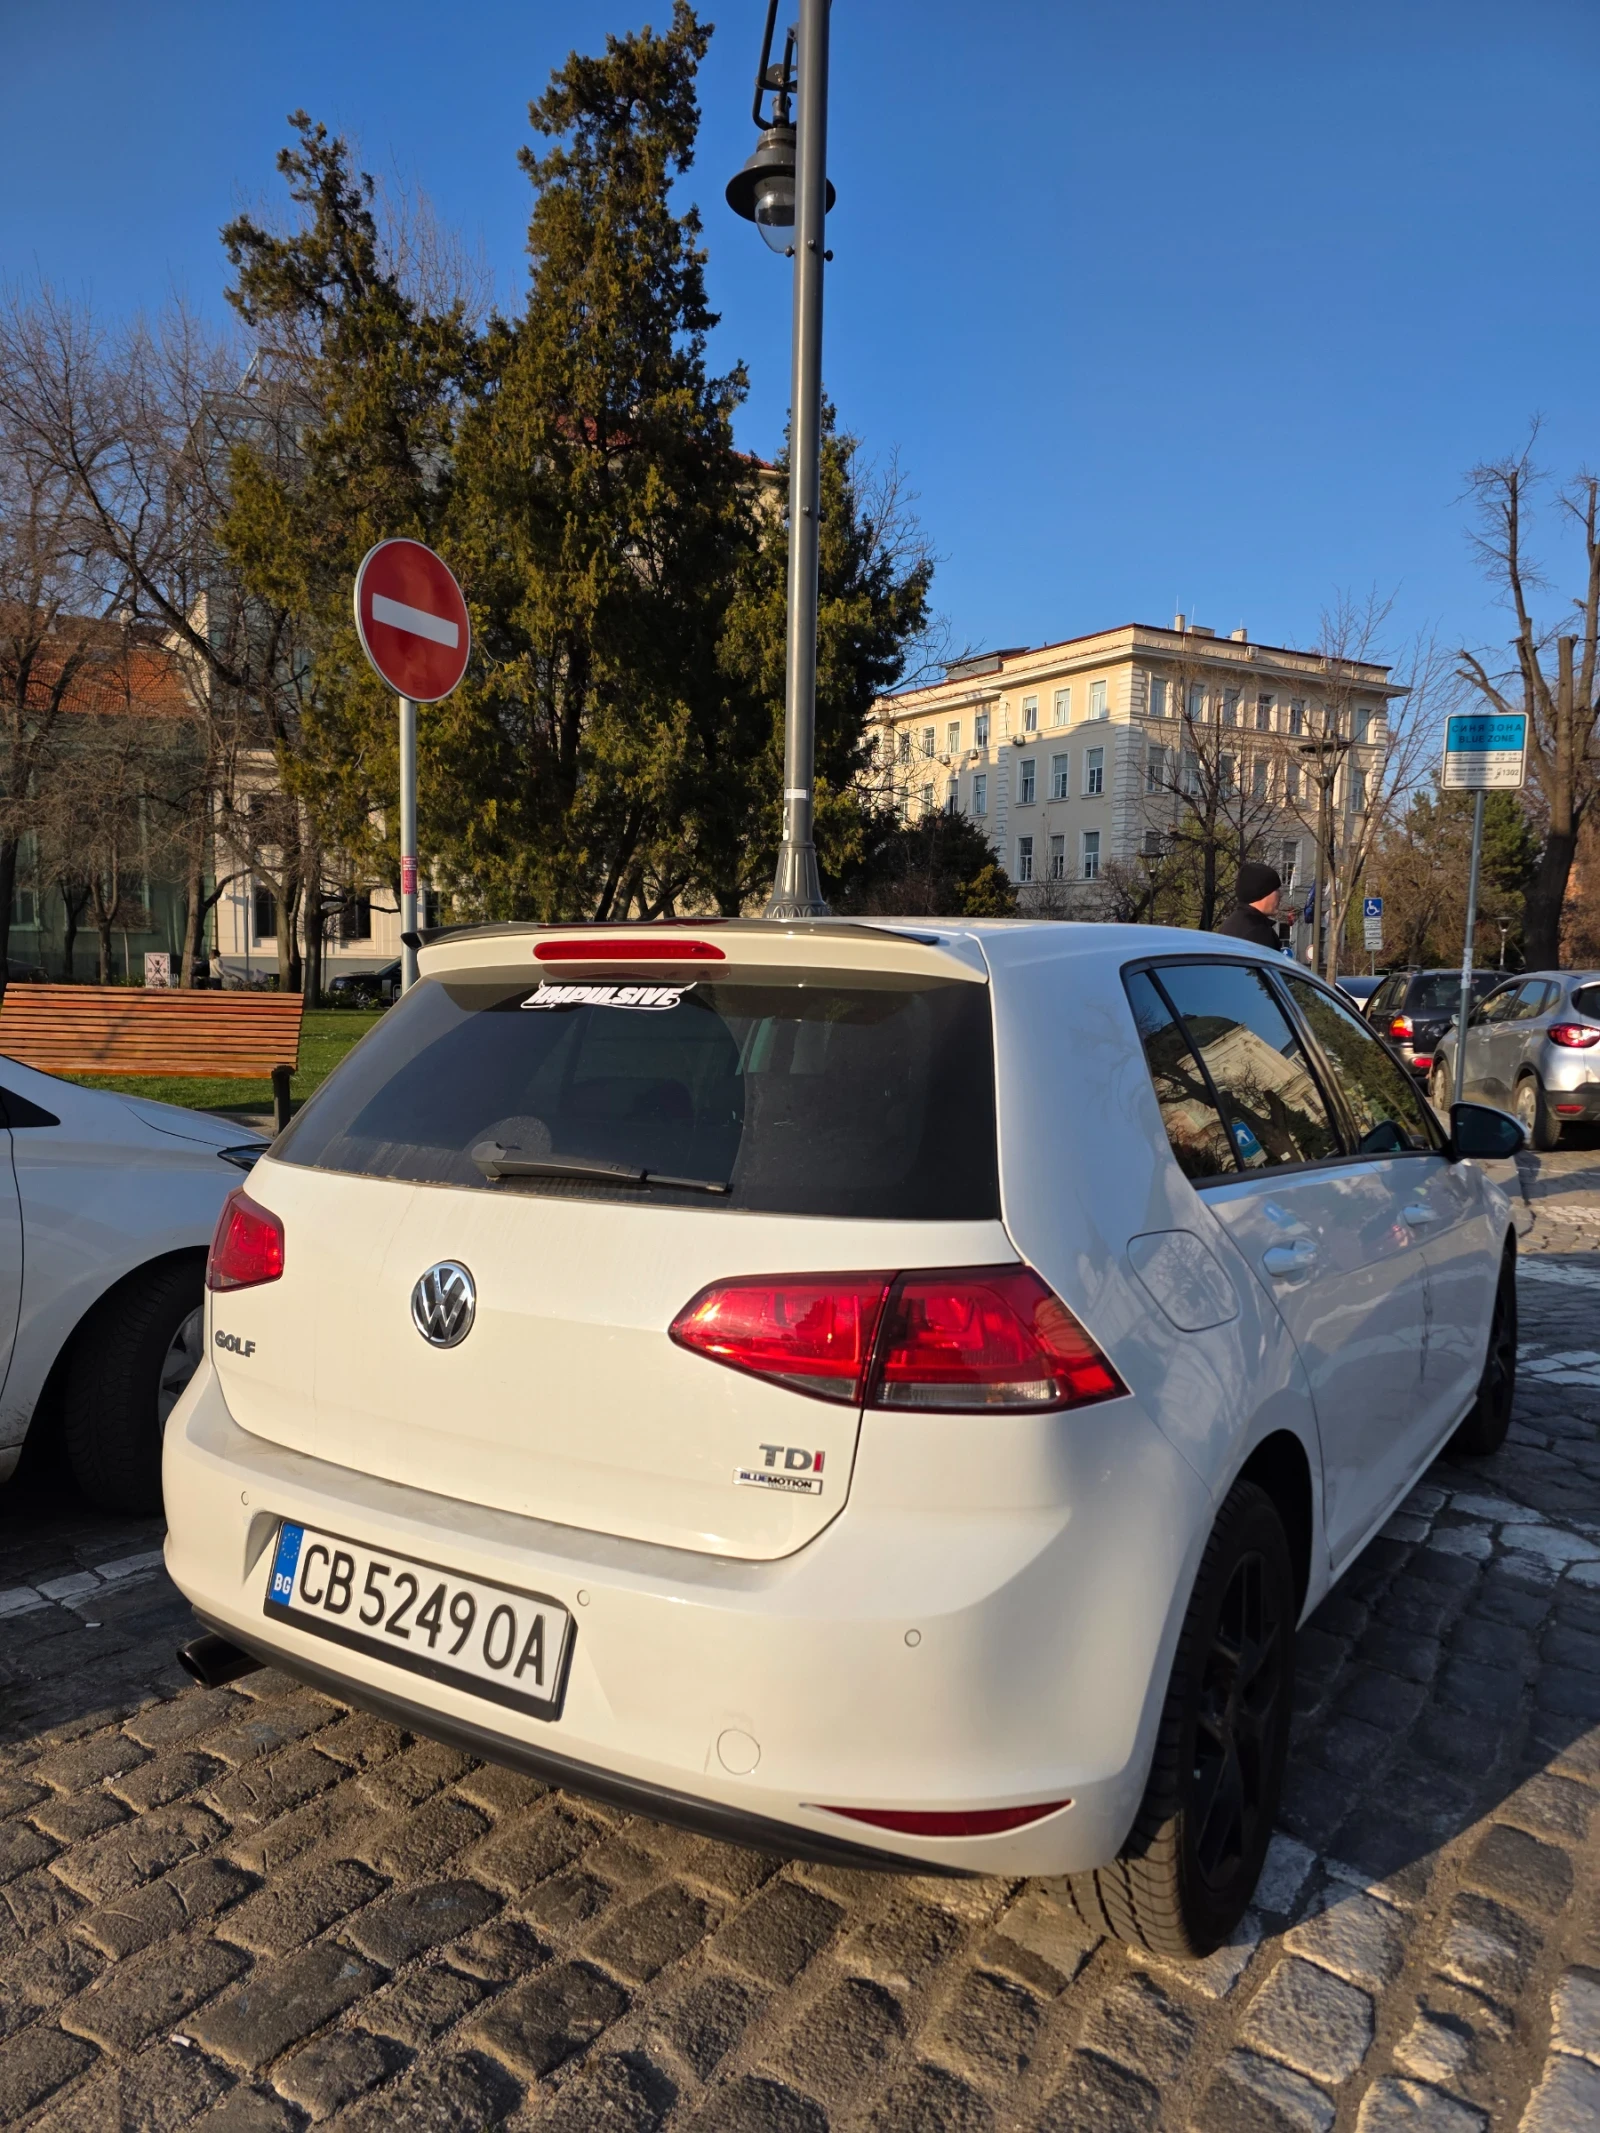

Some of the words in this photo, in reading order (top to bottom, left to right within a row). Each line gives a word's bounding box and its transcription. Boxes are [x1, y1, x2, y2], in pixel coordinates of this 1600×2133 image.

[1451, 724, 1485, 733] СИНЯ
[1488, 723, 1522, 732] ЗОНА
[1458, 735, 1485, 743] BLUE
[1487, 734, 1515, 743] ZONE
[524, 984, 688, 1007] IMPULSIVE
[214, 1329, 256, 1357] GOLF
[758, 1443, 826, 1473] TDI
[739, 1471, 812, 1488] BLUEMOTION
[273, 1572, 292, 1595] BG
